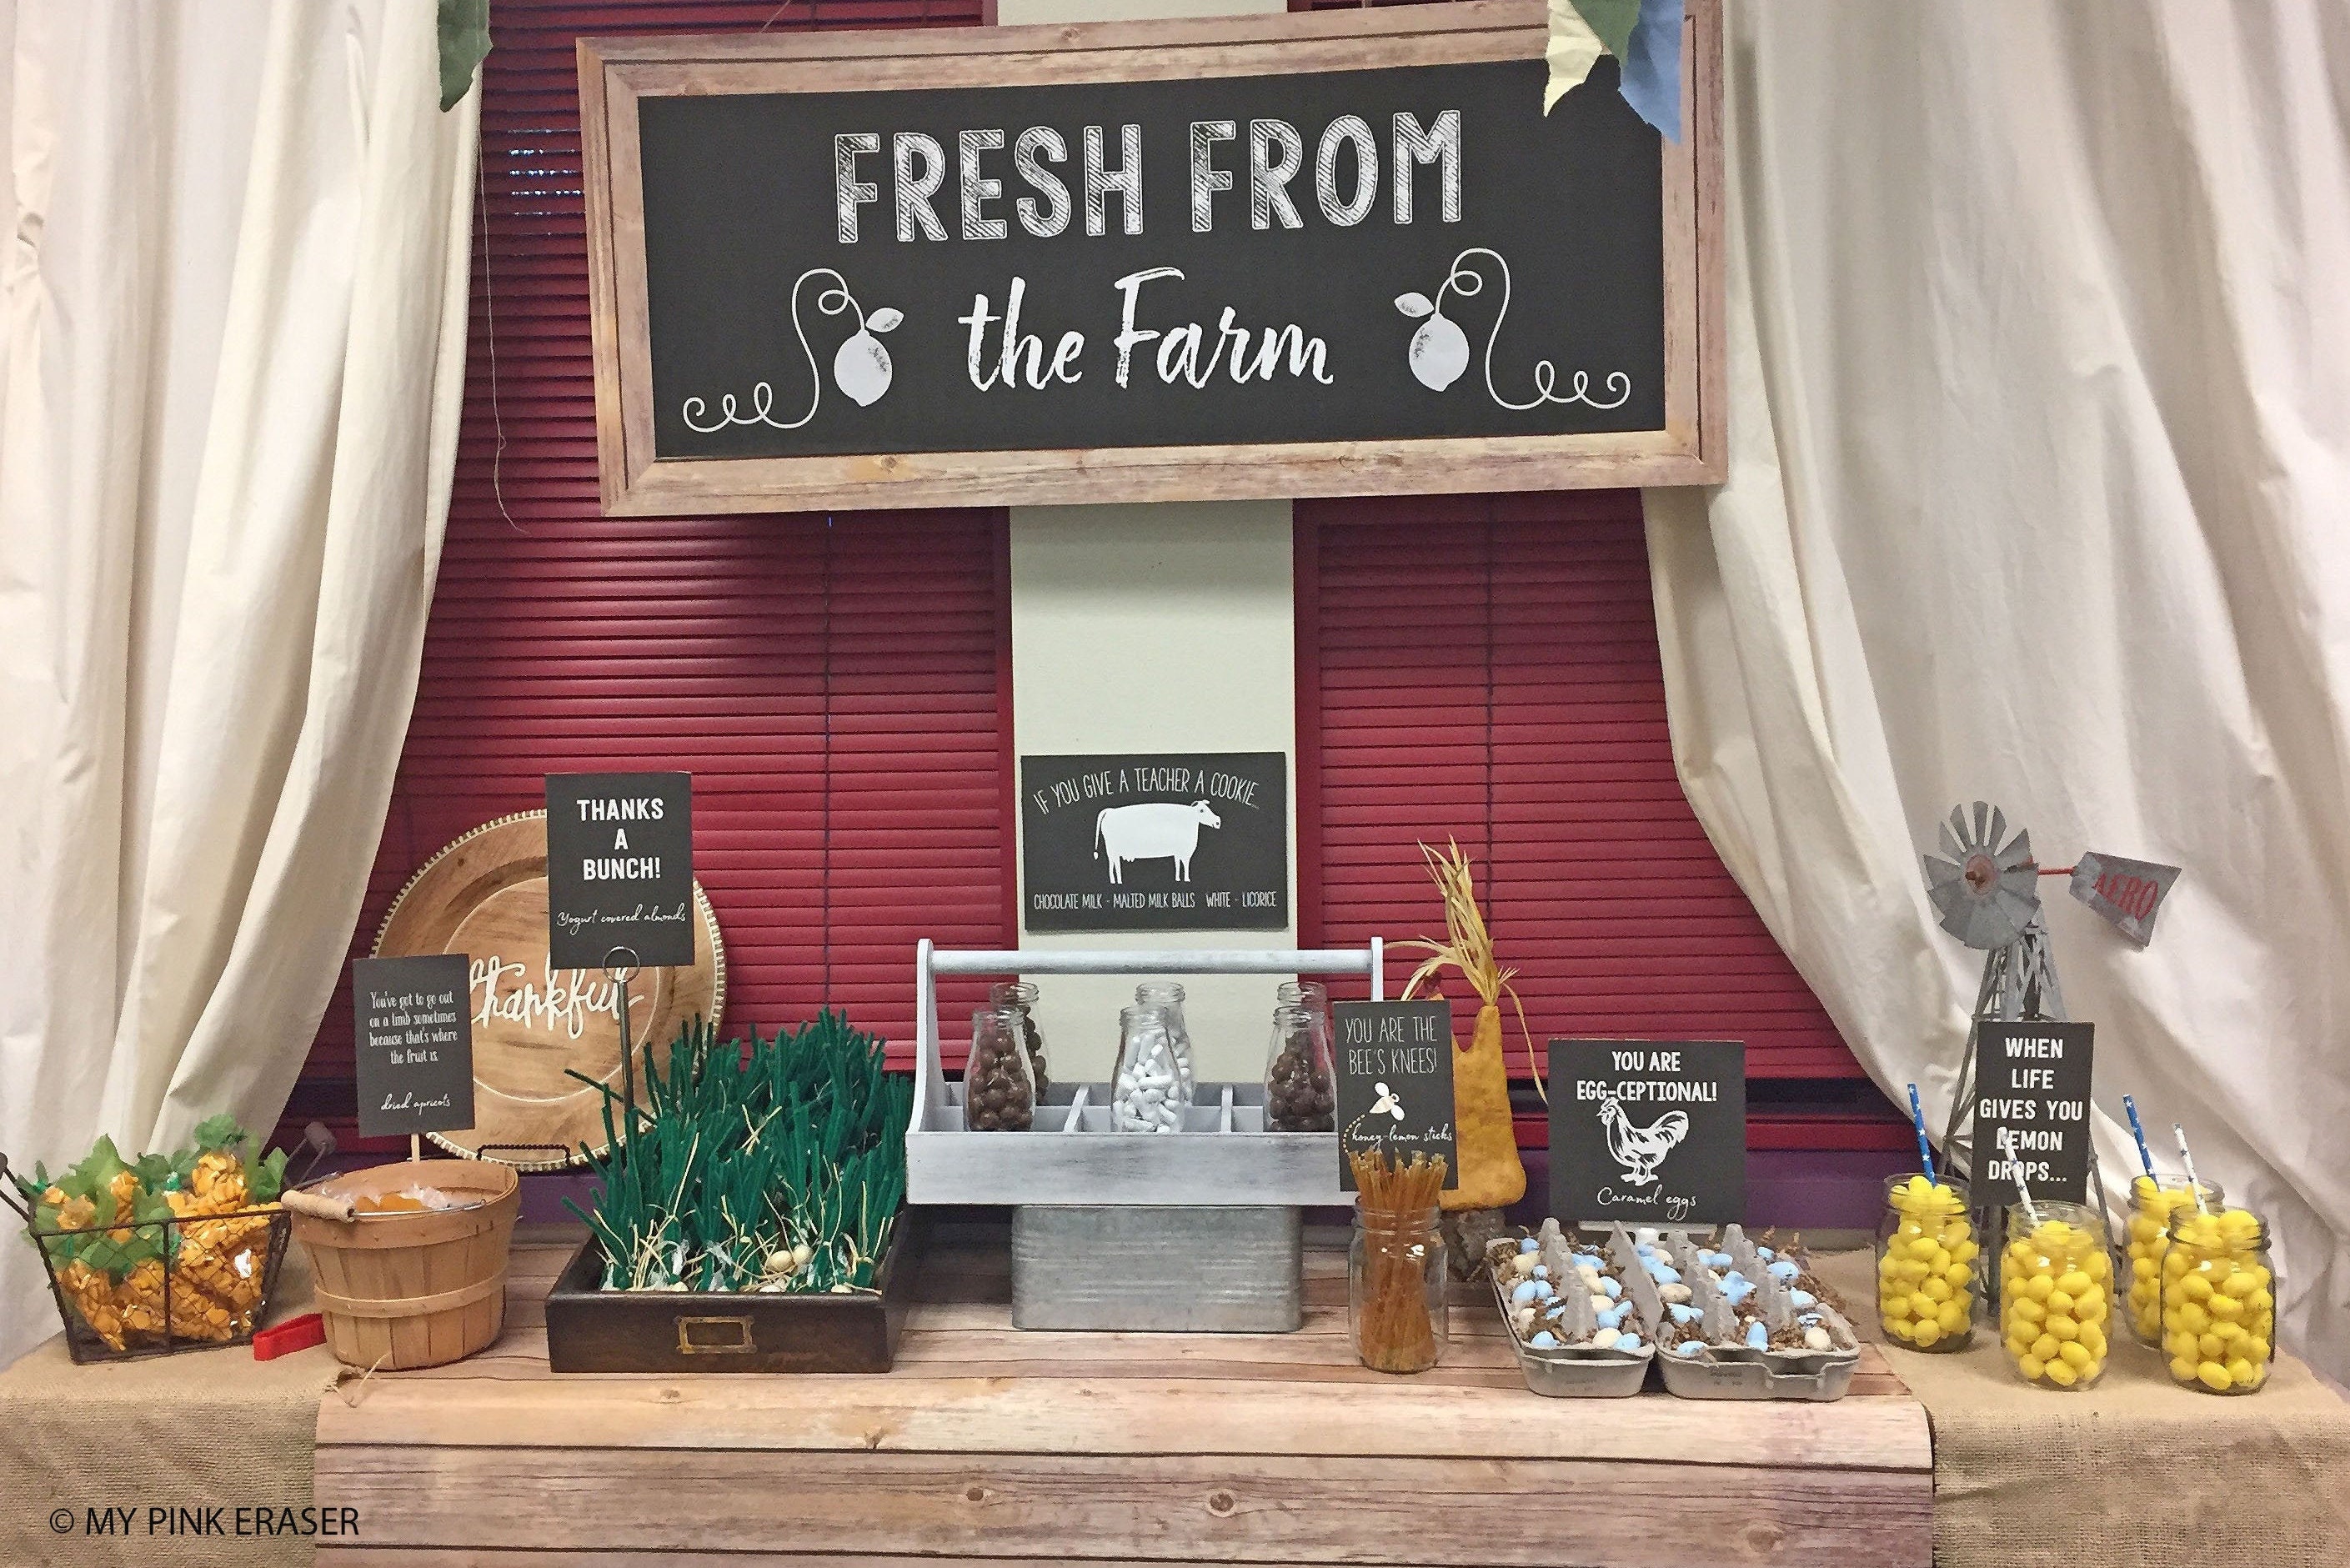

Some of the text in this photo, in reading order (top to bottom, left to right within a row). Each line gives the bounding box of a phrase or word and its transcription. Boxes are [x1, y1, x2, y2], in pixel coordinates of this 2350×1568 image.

[834, 109, 1462, 244] FRESH FROM
[957, 266, 1334, 393] the Farm
[1033, 786, 1052, 815] IF
[1050, 778, 1080, 808] YOU
[1082, 770, 1115, 799] GIVE
[1119, 769, 1130, 794] A
[1134, 767, 1190, 793] TEACHER
[1194, 769, 1205, 795] A
[576, 797, 664, 822] THANKS
[614, 828, 629, 850] A
[583, 856, 661, 881] BUNCH!
[1033, 893, 1080, 910] CHOCOLATE
[1081, 893, 1103, 909] MILK
[1113, 892, 1146, 909] MALTED
[1148, 892, 1169, 909] MILK
[1171, 891, 1196, 909] BALLS
[1205, 891, 1231, 908] WHITE
[1241, 890, 1278, 908] LICORICE
[600, 903, 644, 924] covered
[644, 902, 686, 922] almonds
[398, 992, 413, 1011] got
[415, 992, 425, 1006] to
[368, 1031, 403, 1047] because
[1345, 1015, 1438, 1044] YOU ARE THE
[390, 1050, 404, 1065] the
[2005, 1037, 2063, 1059] WHEN
[1346, 1047, 1437, 1075] BEE'S KNEES!
[1611, 1050, 1681, 1072] YOU ARE
[2011, 1067, 2055, 1090] LIFE
[1576, 1080, 1717, 1104] EGG-CEPTIONAL!
[1979, 1098, 2083, 1121] GIVES YOU
[1996, 1128, 2064, 1152] LEMON
[1596, 1182, 1696, 1222] Caramel eggs
